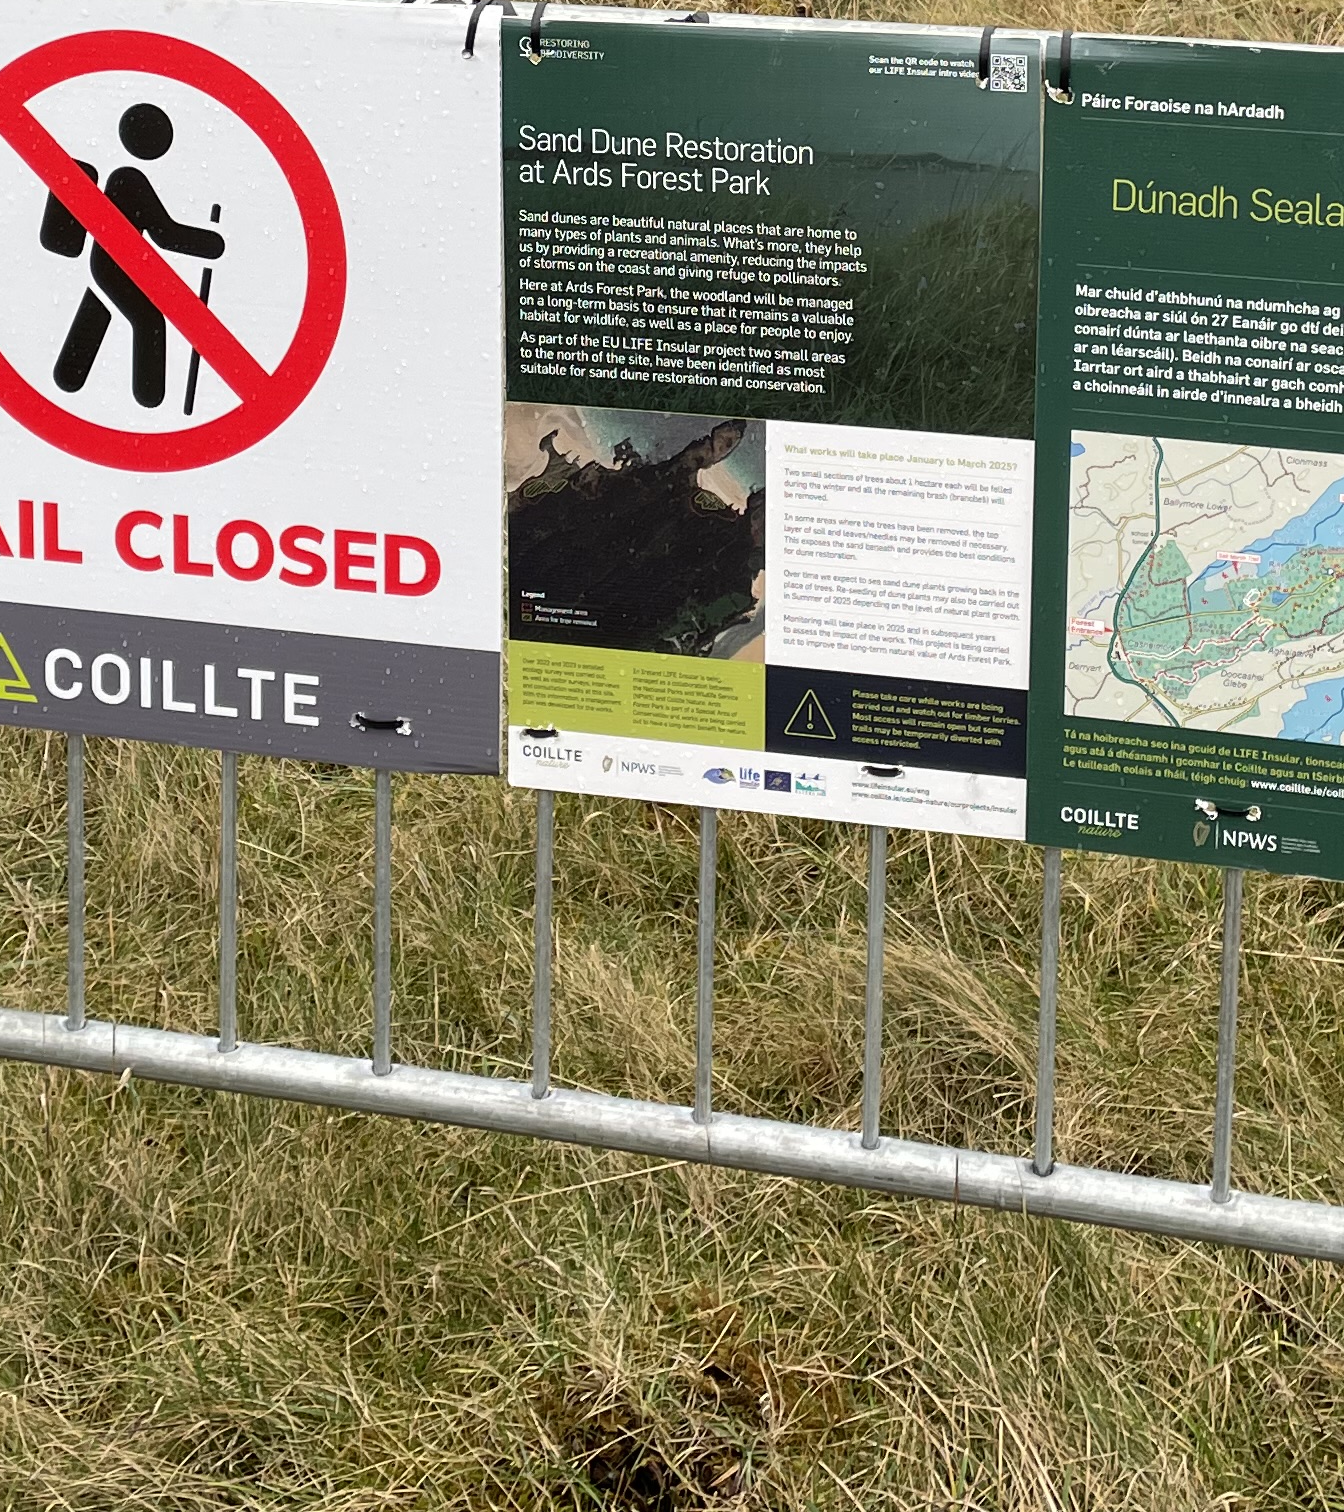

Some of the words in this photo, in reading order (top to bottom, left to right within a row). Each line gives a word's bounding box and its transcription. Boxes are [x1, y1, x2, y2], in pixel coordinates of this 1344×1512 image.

[540, 38, 590, 48] RESTORING
[869, 55, 889, 64] Scan
[891, 57, 903, 65] the
[905, 57, 917, 65] QR
[919, 58, 938, 66] code
[940, 59, 948, 67] to
[950, 60, 974, 68] watch
[884, 67, 905, 75] LIFE
[907, 68, 937, 76] Insular
[939, 69, 957, 77] intro
[1081, 93, 1121, 108] Páirc
[1124, 96, 1191, 112] Foraoise
[1193, 103, 1213, 113] na
[1217, 100, 1284, 117] hArdadh
[518, 124, 582, 153] Sand
[591, 128, 657, 158] Dune
[666, 132, 814, 165] Restoration
[519, 161, 545, 184] at
[552, 161, 612, 188] Ards
[621, 163, 704, 193] Forest
[711, 168, 770, 196] Park
[1112, 178, 1238, 220] Dúnadh
[518, 210, 548, 223] Sand
[550, 211, 587, 225] dunes
[589, 217, 609, 226] are
[611, 215, 664, 229] beautiful
[667, 218, 711, 231] natural
[713, 220, 753, 236] places
[755, 222, 781, 235] that
[783, 227, 804, 236] are
[806, 225, 841, 238] home
[843, 227, 857, 239] to
[518, 230, 552, 244] many
[553, 228, 587, 245] types
[589, 230, 601, 242] of
[603, 231, 642, 247] plants
[643, 233, 666, 245] and
[668, 235, 720, 248] animals.
[722, 237, 764, 250] What's
[766, 243, 802, 257] more,
[804, 241, 832, 258] they
[834, 242, 862, 260] help
[1075, 284, 1103, 299] Mar
[1104, 287, 1142, 302] chuid
[1144, 289, 1222, 308] d'athbhunú
[1225, 299, 1243, 309] na
[1246, 297, 1320, 315] ndumhcha
[1322, 307, 1340, 321] ag
[1074, 304, 1141, 321] oibreacha
[1144, 313, 1160, 323] ar
[1161, 311, 1188, 325] siúl
[1190, 312, 1208, 326] ón
[1211, 314, 1229, 328] 27
[1231, 316, 1278, 332] Eanáir
[1279, 323, 1298, 337] go
[1300, 321, 1320, 335] dtí
[519, 331, 536, 344] As
[537, 334, 563, 349] part
[564, 335, 577, 346] of
[579, 335, 599, 347] the
[601, 336, 619, 349] EU
[622, 338, 653, 351] LIFE
[655, 340, 701, 354] Insular
[702, 344, 746, 360] project
[747, 345, 771, 358] two
[773, 348, 809, 360] small
[810, 353, 845, 362] areas
[114, 510, 441, 596] CLOSED
[44, 647, 320, 727] COILLTE
[523, 745, 582, 762] COILLTE
[621, 761, 656, 775] NPWS
[739, 767, 760, 781] life
[1062, 757, 1075, 768] Le
[1077, 758, 1121, 773] tuilleadh
[1122, 764, 1153, 776] eolais
[1163, 768, 1188, 784] fháil,
[1190, 770, 1216, 786] téigh
[1061, 806, 1139, 830] COILLTE
[1077, 825, 1121, 838] nature
[1223, 830, 1277, 852] NPWS
